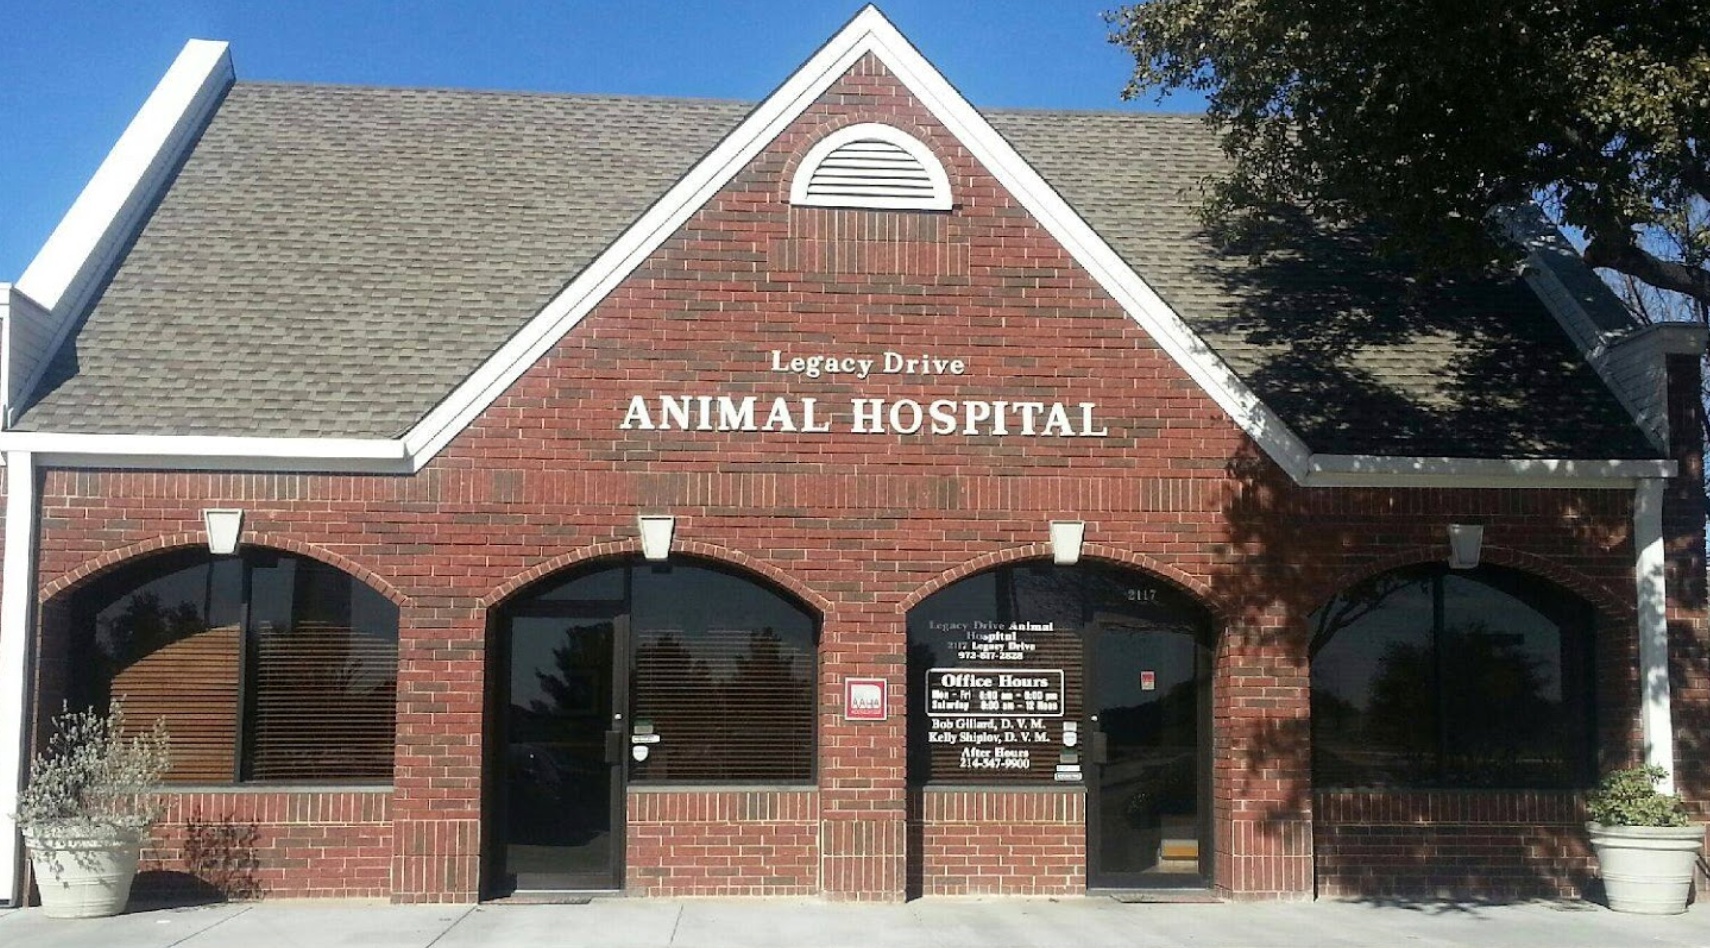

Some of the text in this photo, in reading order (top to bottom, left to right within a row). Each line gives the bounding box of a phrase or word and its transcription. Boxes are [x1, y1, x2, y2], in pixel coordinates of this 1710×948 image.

[771, 349, 965, 380] Legacy Drive
[619, 394, 1109, 438] ANIMAL HOSPITAL
[1127, 588, 1157, 601] 2117
[928, 620, 1054, 632] Legacy Drive Animal
[966, 631, 1017, 643] Hospital
[971, 641, 1005, 651] Legacy
[1008, 641, 1036, 651] Drive
[940, 673, 1049, 688] Office Hours
[931, 689, 950, 700] Mon
[960, 689, 972, 700] Fri
[931, 700, 970, 711] Saturday
[1025, 700, 1035, 711] 12
[931, 718, 954, 729] Bob
[1000, 718, 1014, 729] D.
[1016, 718, 1027, 729] V.
[1030, 718, 1046, 729] M.
[928, 731, 957, 744] Kelly
[1004, 731, 1018, 742] D.
[1020, 731, 1031, 742] V.
[1034, 731, 1051, 742] M.
[961, 746, 1029, 758] After Hours
